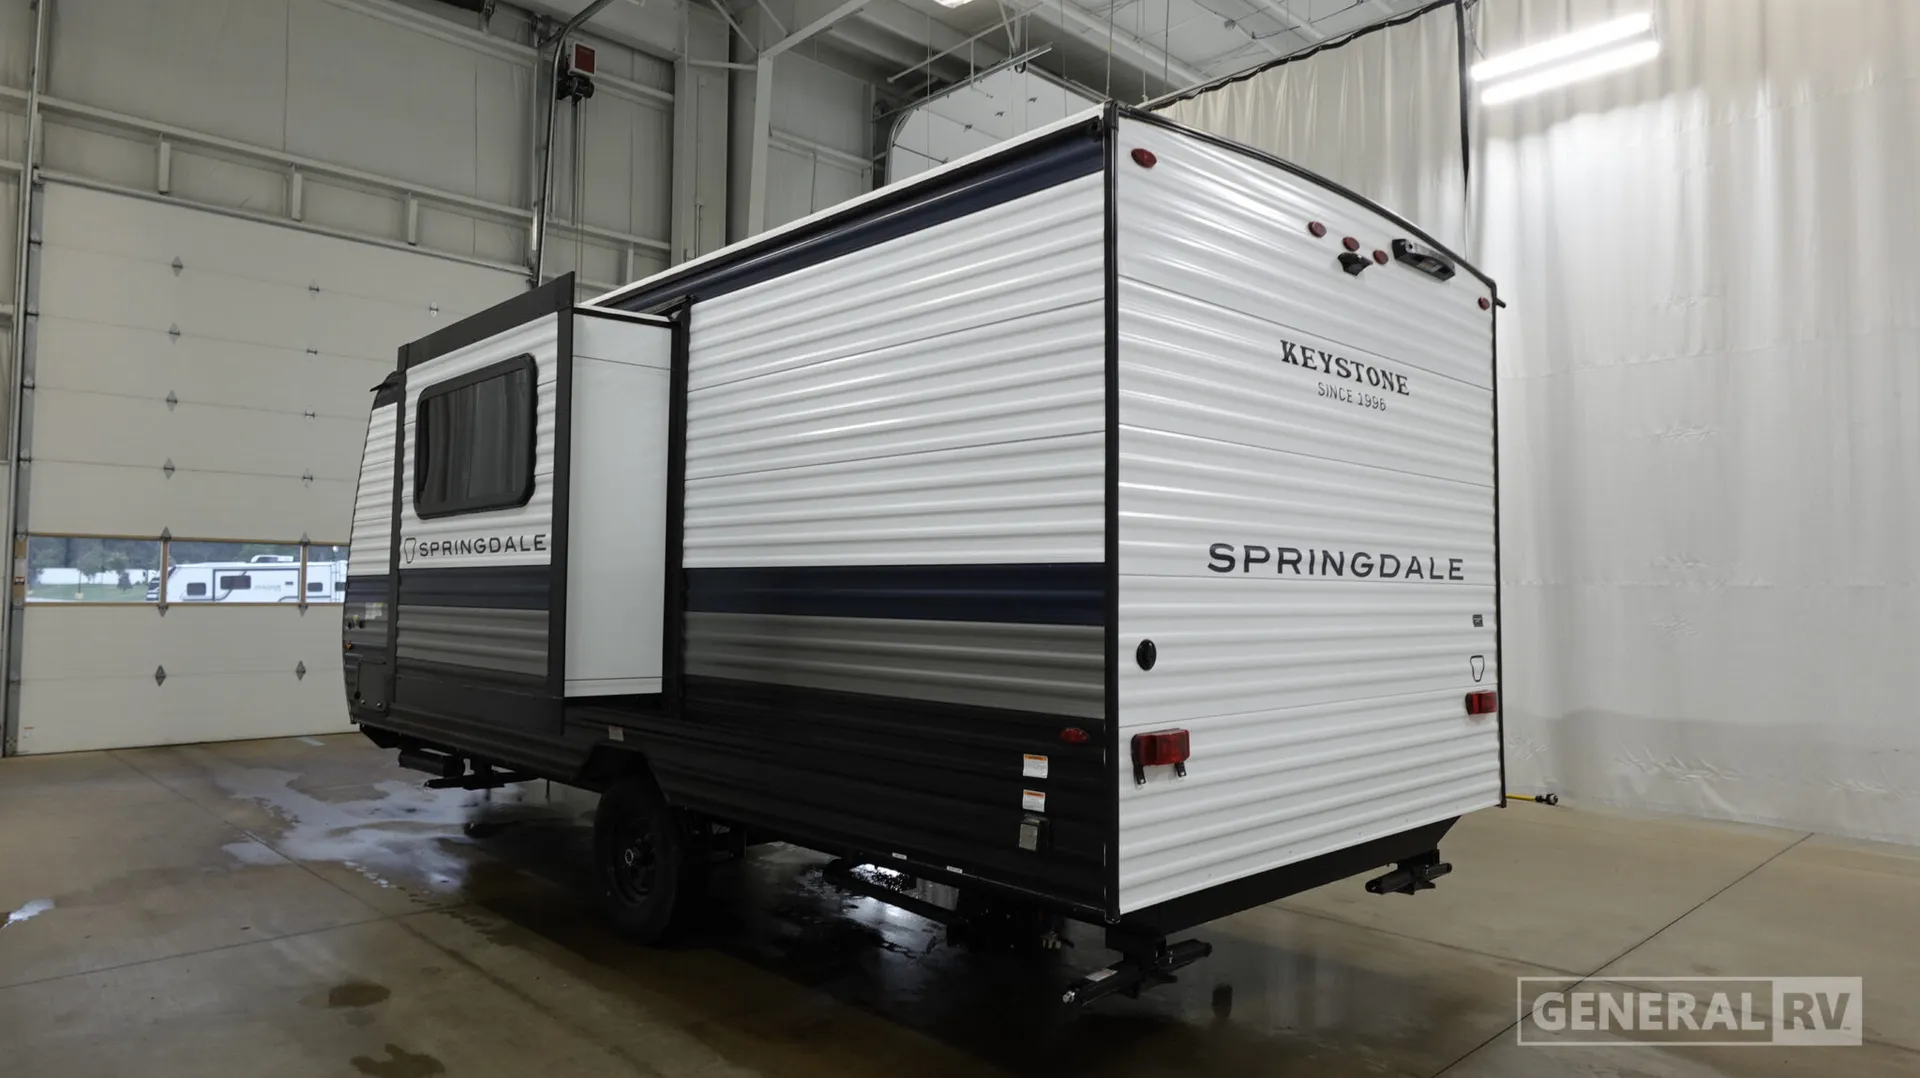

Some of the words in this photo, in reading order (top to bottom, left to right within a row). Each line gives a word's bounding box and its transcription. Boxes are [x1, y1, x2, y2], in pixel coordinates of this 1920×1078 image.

[1280, 339, 1410, 396] KEYSTONE
[1318, 381, 1353, 404] SINCE
[1357, 392, 1387, 412] 1996
[419, 534, 547, 557] SPRINGDALE
[1207, 542, 1464, 581] SPRINGDALE
